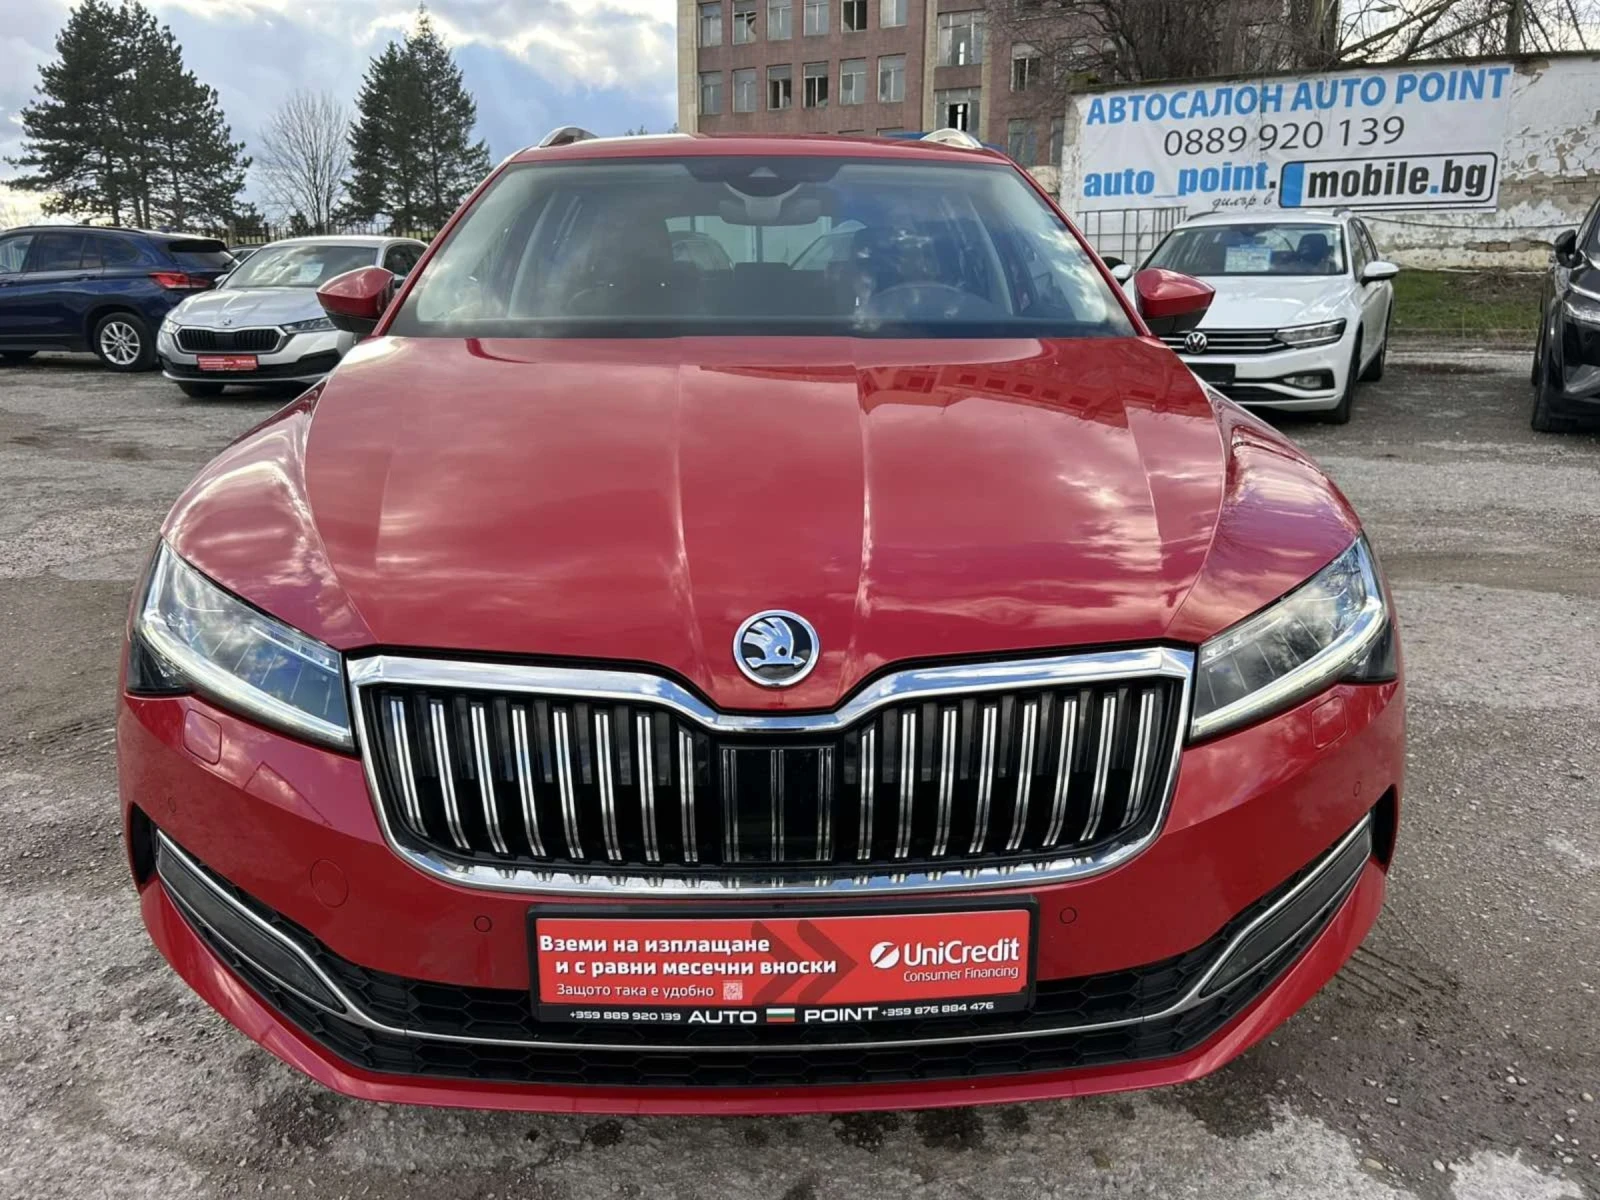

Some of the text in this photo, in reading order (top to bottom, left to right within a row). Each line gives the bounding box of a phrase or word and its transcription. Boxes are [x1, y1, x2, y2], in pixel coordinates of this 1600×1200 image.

[1086, 67, 1511, 125] АВТОСАЛОН AUTO POINT
[1163, 115, 1405, 156] 0889 920 139
[1307, 159, 1488, 199] mobile.bg
[539, 934, 770, 955] Вземи на изплащане
[903, 937, 1020, 967] UniCredit
[555, 960, 837, 978] и с равни месечни вноски
[903, 966, 1019, 983] Consumer Financing
[556, 983, 715, 999] Защото така е удобно
[569, 1010, 601, 1020] +359
[631, 1012, 658, 1021] 920
[660, 1012, 681, 1021] 139
[687, 1010, 758, 1024] AUTO
[804, 1007, 878, 1023] POINT
[880, 1006, 912, 1017] +359
[914, 1005, 939, 1015] 876
[941, 1003, 967, 1014] 884
[969, 1001, 995, 1011] 476
